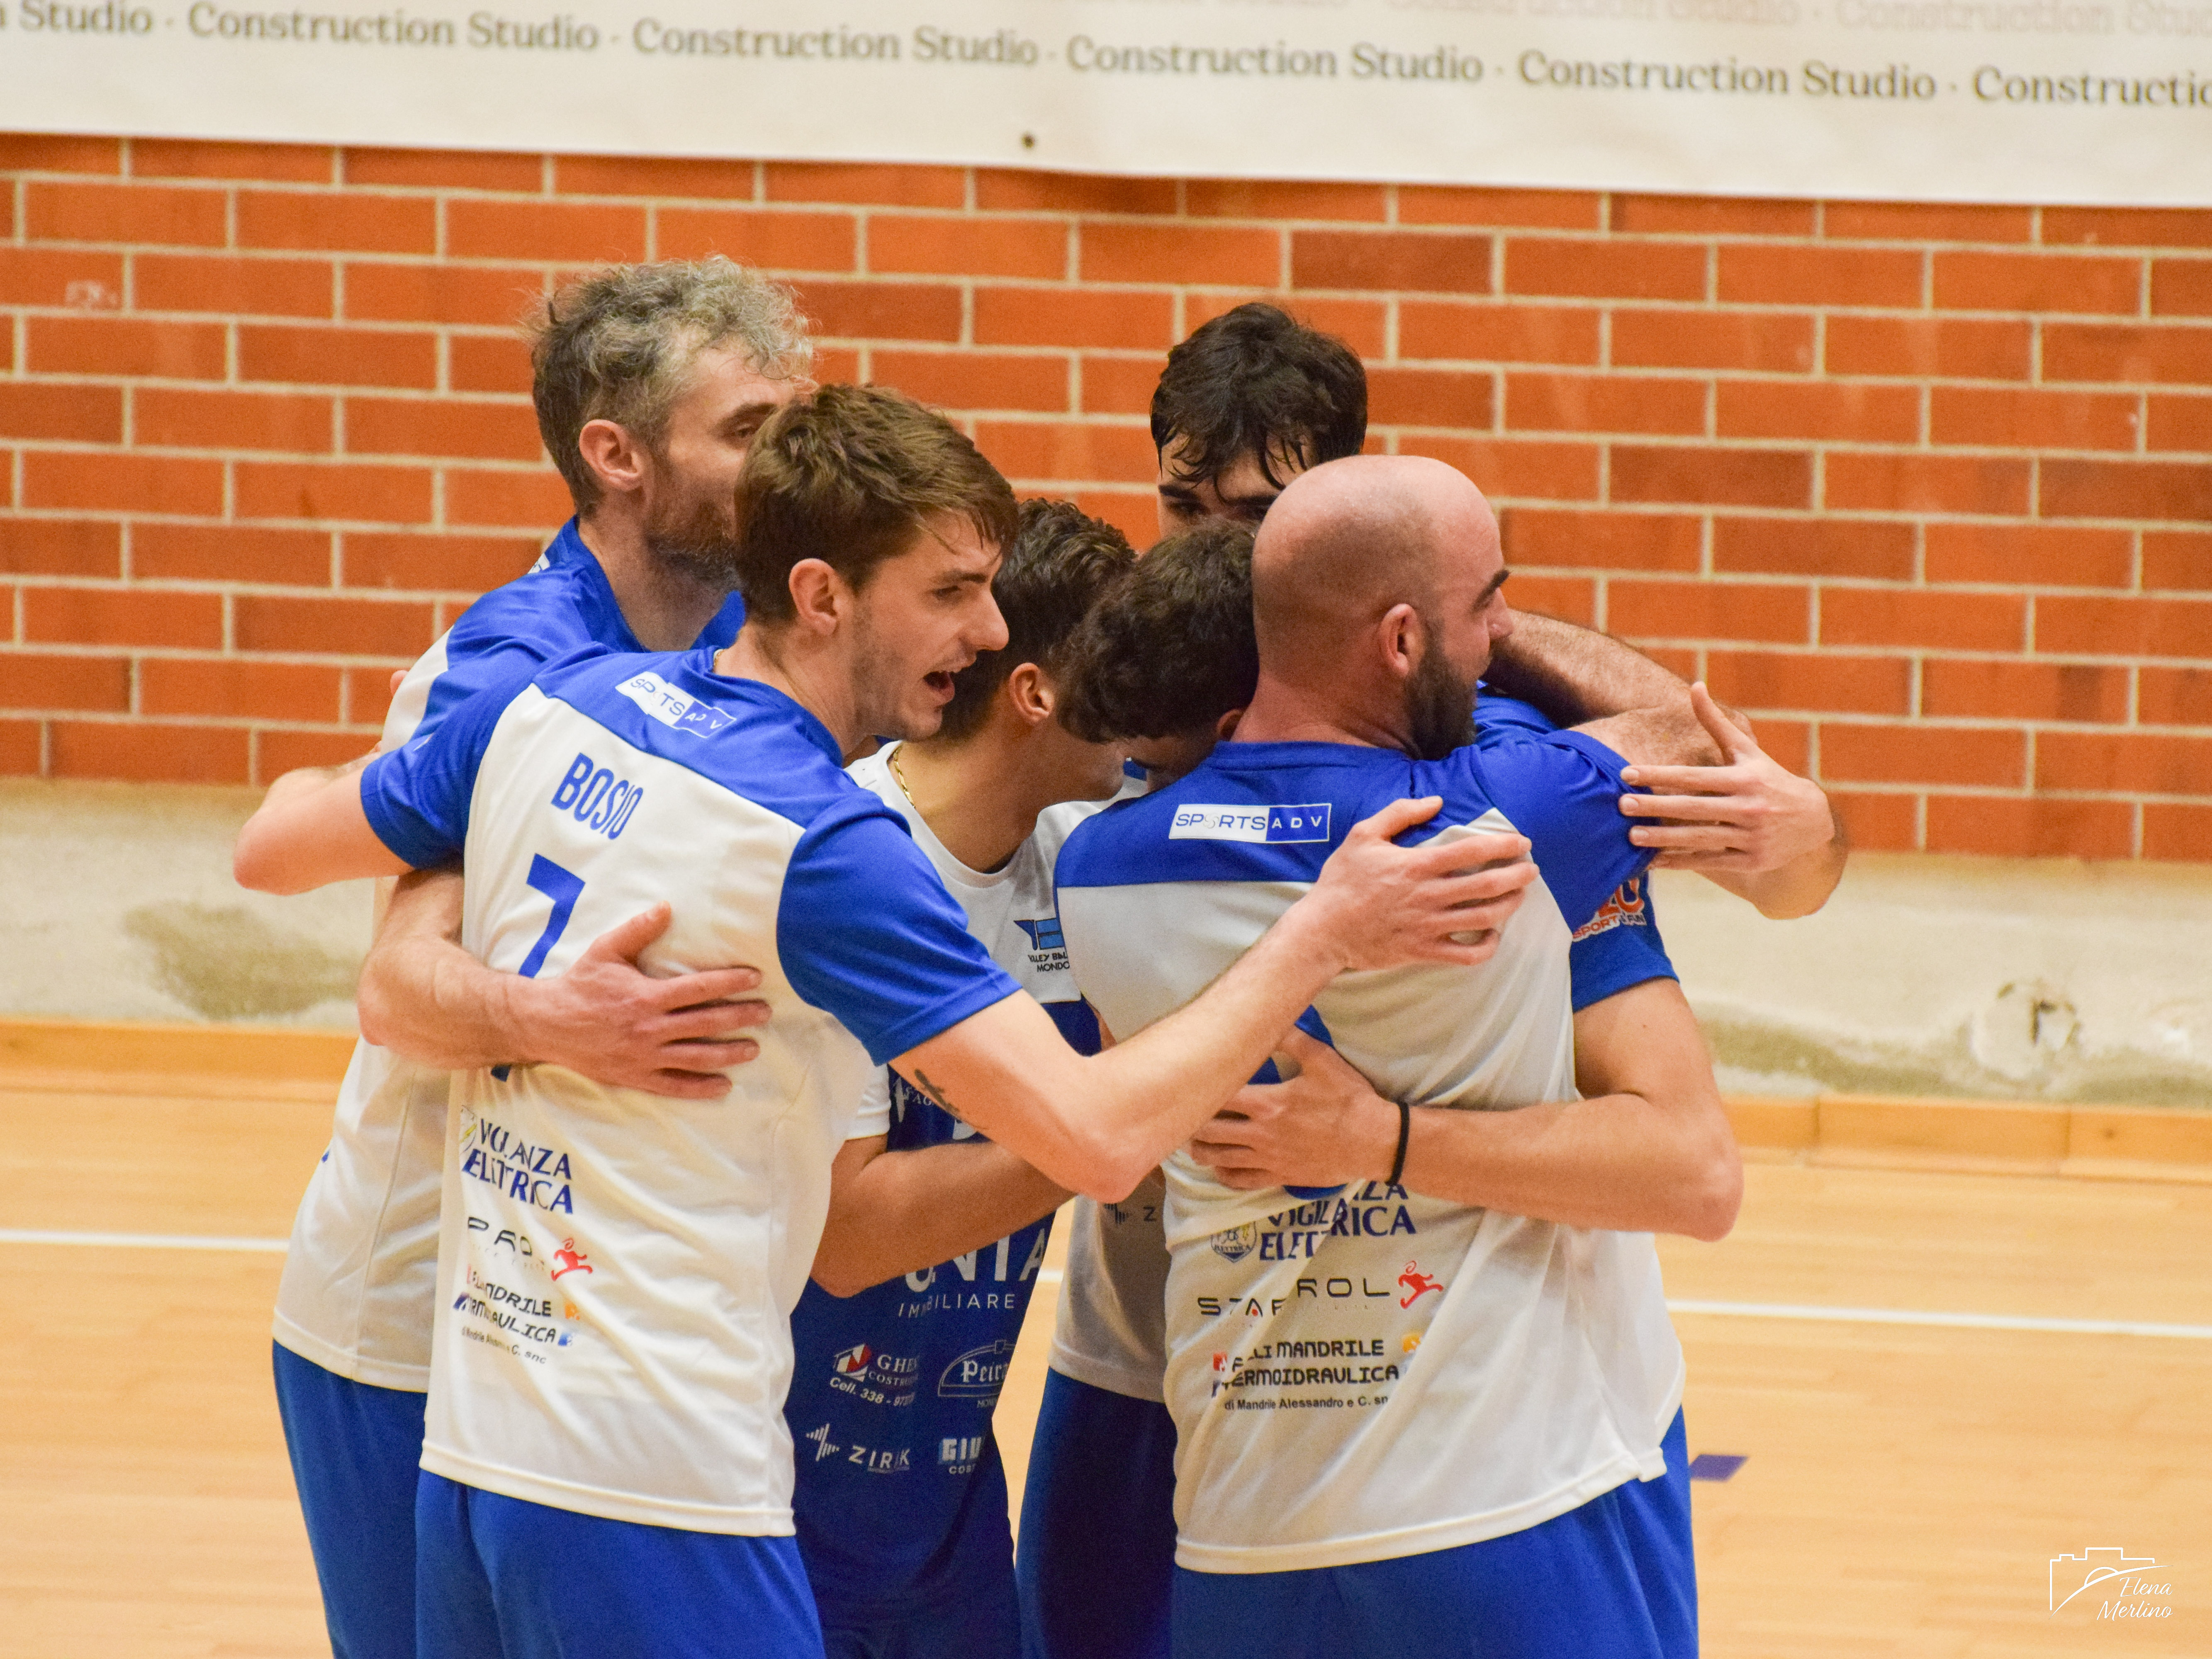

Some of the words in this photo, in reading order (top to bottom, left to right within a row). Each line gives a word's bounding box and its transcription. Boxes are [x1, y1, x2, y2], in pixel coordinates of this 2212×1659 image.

[19, 0, 155, 35] Studio
[188, 2, 456, 46] Construction
[467, 11, 601, 51] Studio
[632, 17, 901, 61] Construction
[912, 25, 1040, 67] Studio
[1066, 34, 1338, 78] Construction
[1350, 42, 1484, 83] Studio
[1517, 49, 1789, 95] Construction
[1802, 59, 1937, 101] Studio
[551, 752, 644, 840] BOSIO
[1272, 816, 1322, 829] ADV
[1573, 915, 1618, 939] SPORT
[524, 1351, 547, 1365] snc
[1277, 1340, 1384, 1358] MANDRILE
[830, 1377, 856, 1395] Cell.
[860, 1388, 885, 1404] 338
[1279, 1396, 1343, 1410] Alessandro
[1358, 1396, 1370, 1407] C.
